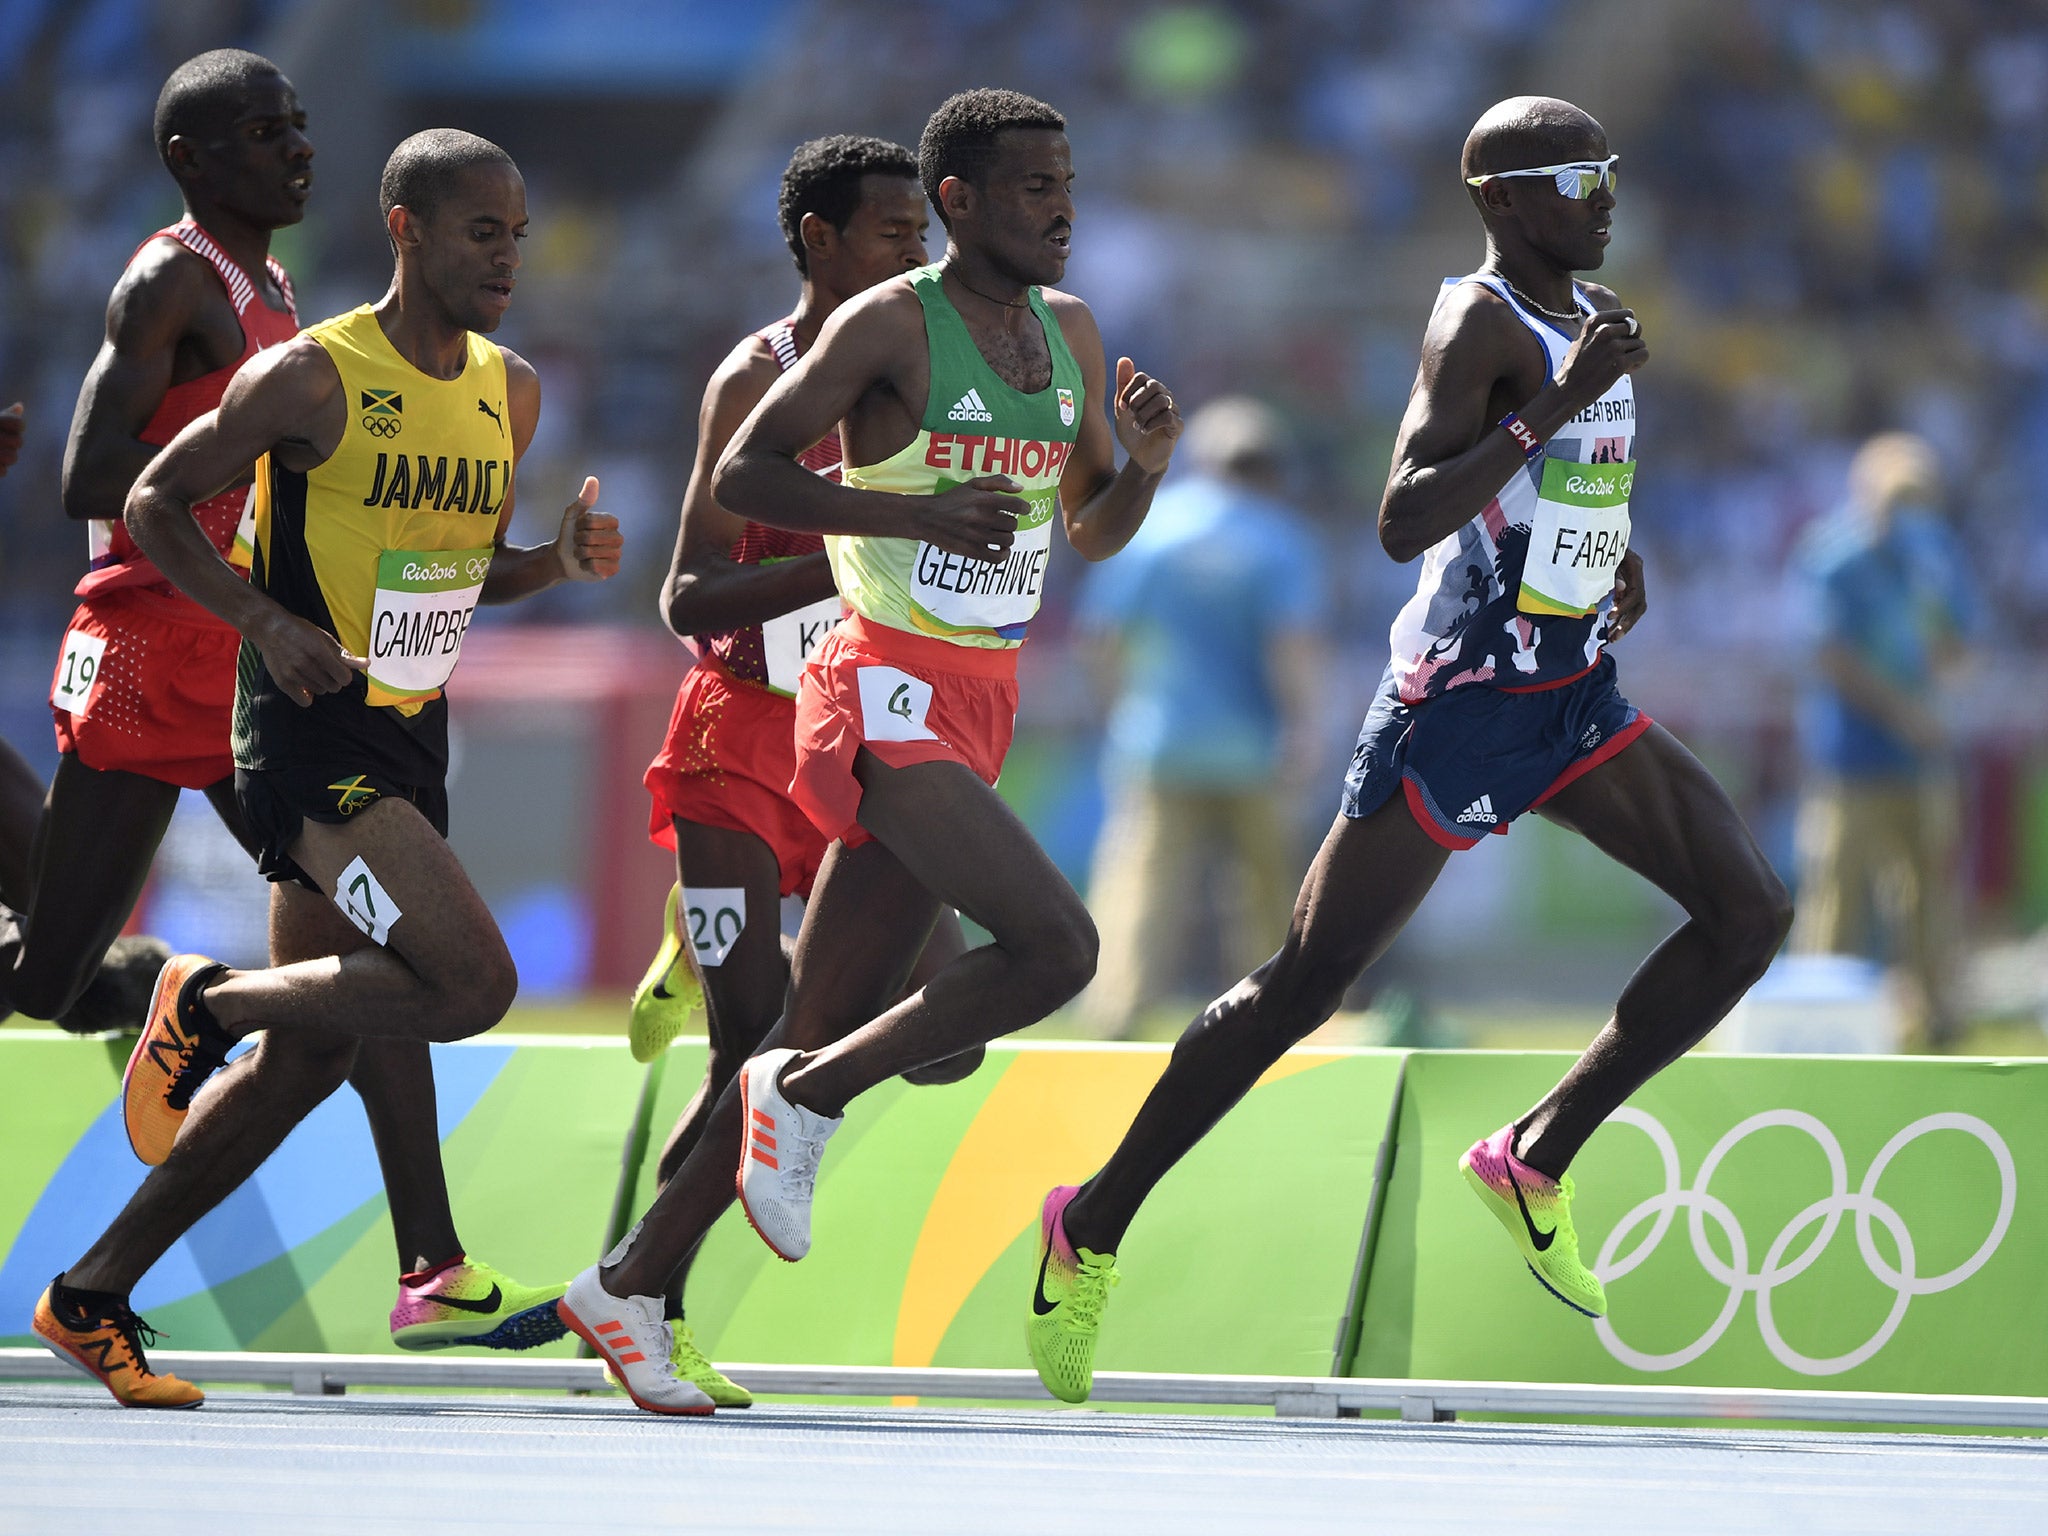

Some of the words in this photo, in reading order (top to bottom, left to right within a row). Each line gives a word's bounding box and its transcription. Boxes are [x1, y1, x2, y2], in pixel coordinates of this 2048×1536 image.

[947, 408, 993, 423] adidas
[924, 431, 1075, 478] ETHIOPI
[1565, 475, 1616, 496] Rio2016
[402, 562, 458, 581] Rio2016
[61, 651, 95, 697] 19
[887, 682, 913, 724] 4
[1456, 811, 1498, 824] adidas
[688, 906, 742, 951] 20
